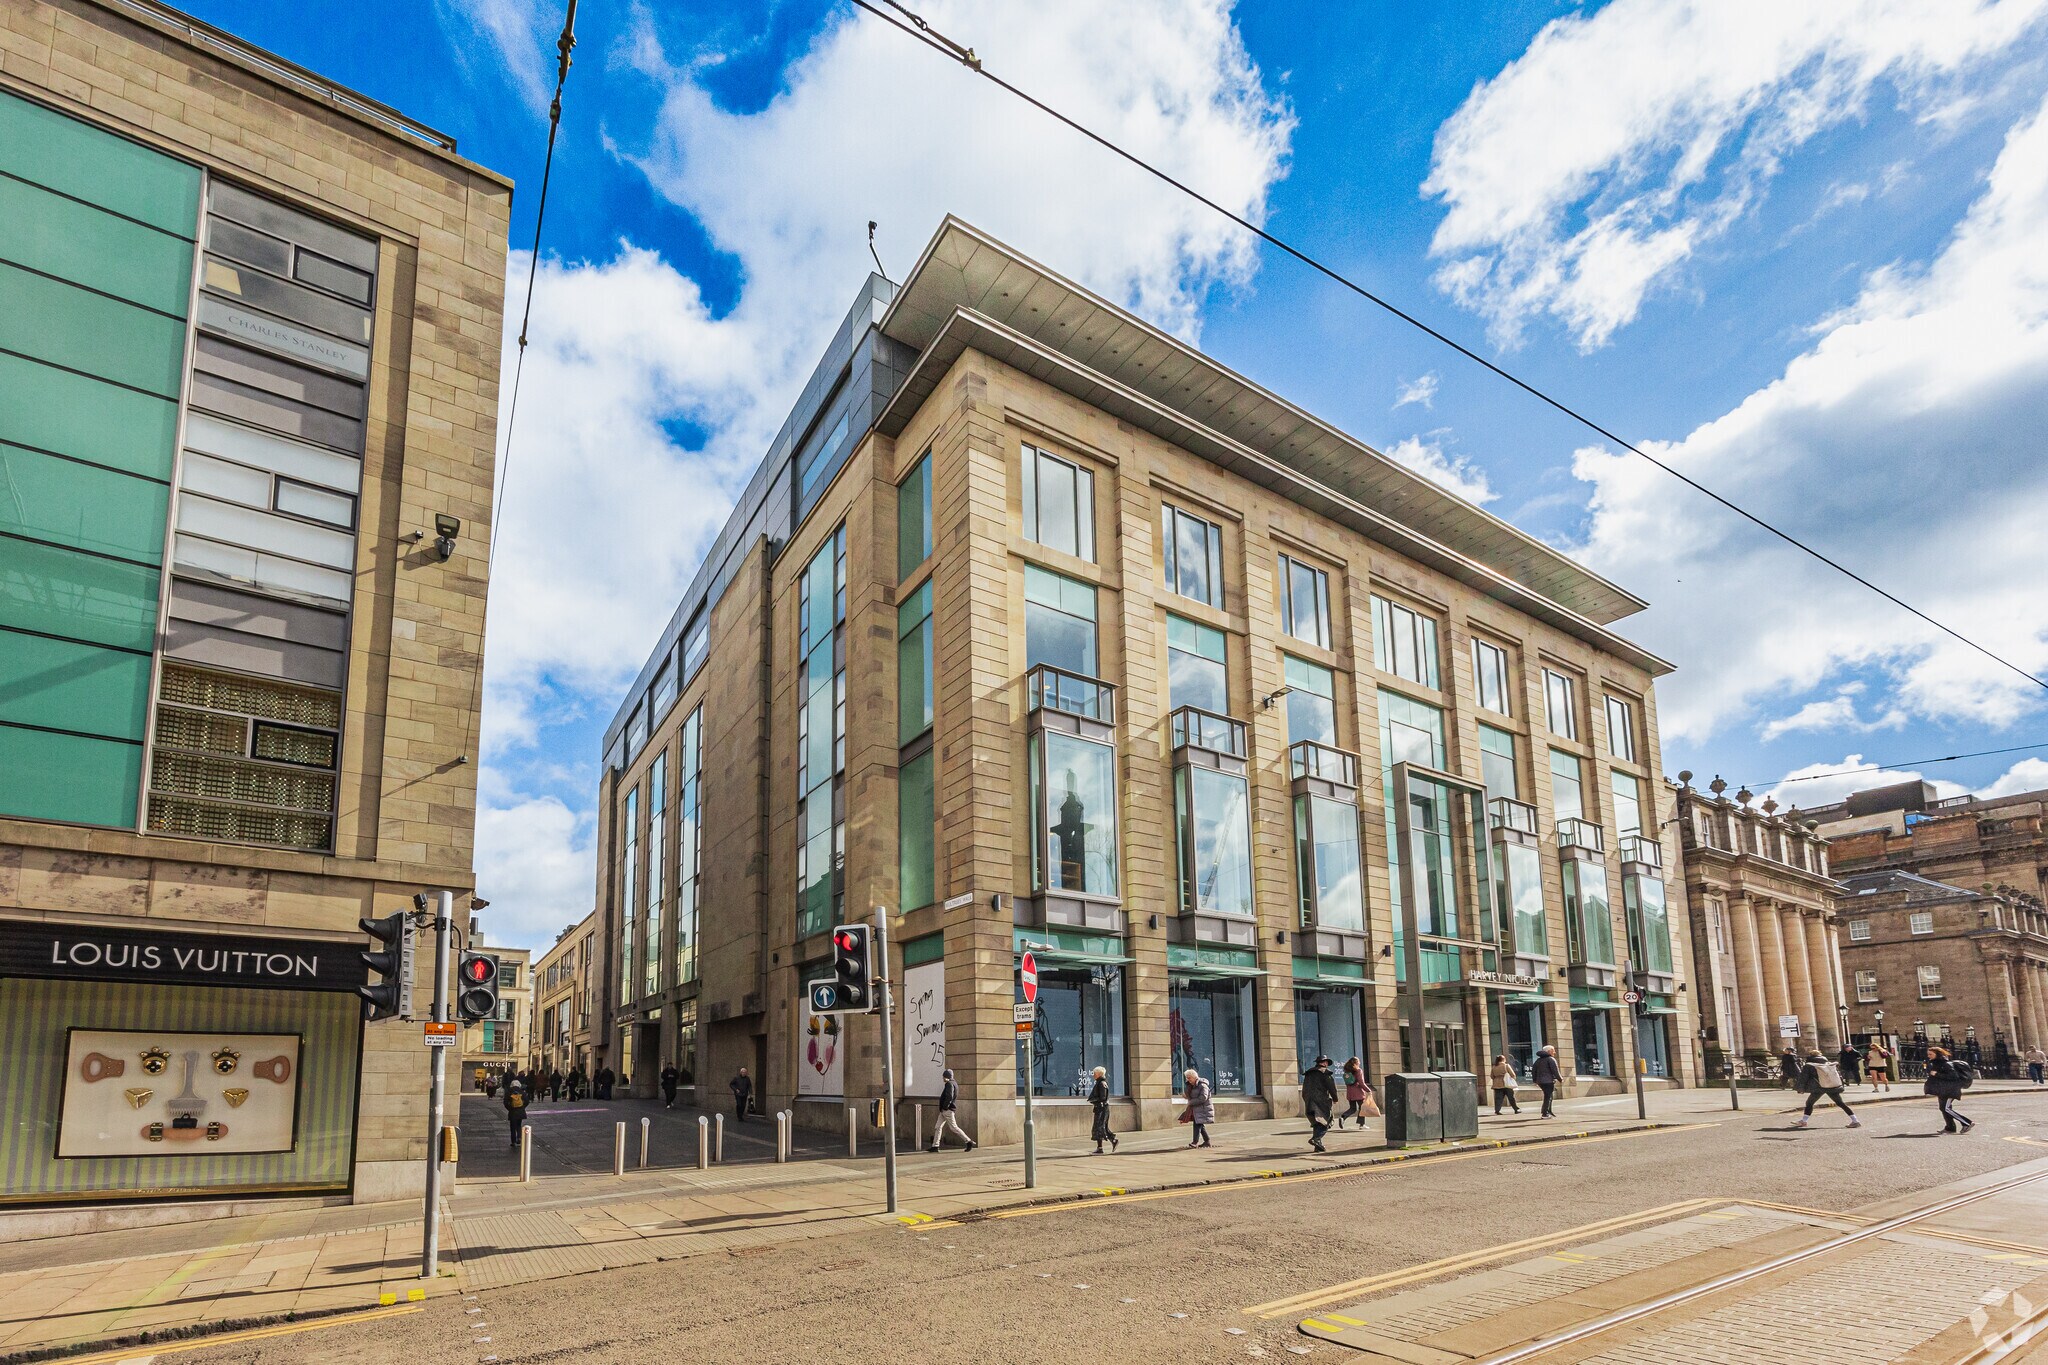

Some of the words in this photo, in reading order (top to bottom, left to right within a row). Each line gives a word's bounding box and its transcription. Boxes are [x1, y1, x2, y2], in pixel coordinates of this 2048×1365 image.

[228, 315, 289, 341] CHARLES
[292, 337, 348, 361] STANLEY
[52, 940, 162, 969] LOUIS
[173, 947, 318, 977] VUITTON
[1470, 969, 1502, 982] HARVEY
[1503, 974, 1540, 987] NICHOLS
[931, 1041, 945, 1068] 25
[1078, 1069, 1087, 1079] Up
[1219, 1070, 1227, 1079] Up
[1078, 1077, 1093, 1086] 20%
[1219, 1078, 1231, 1086] 20%
[1231, 1078, 1240, 1086] off
